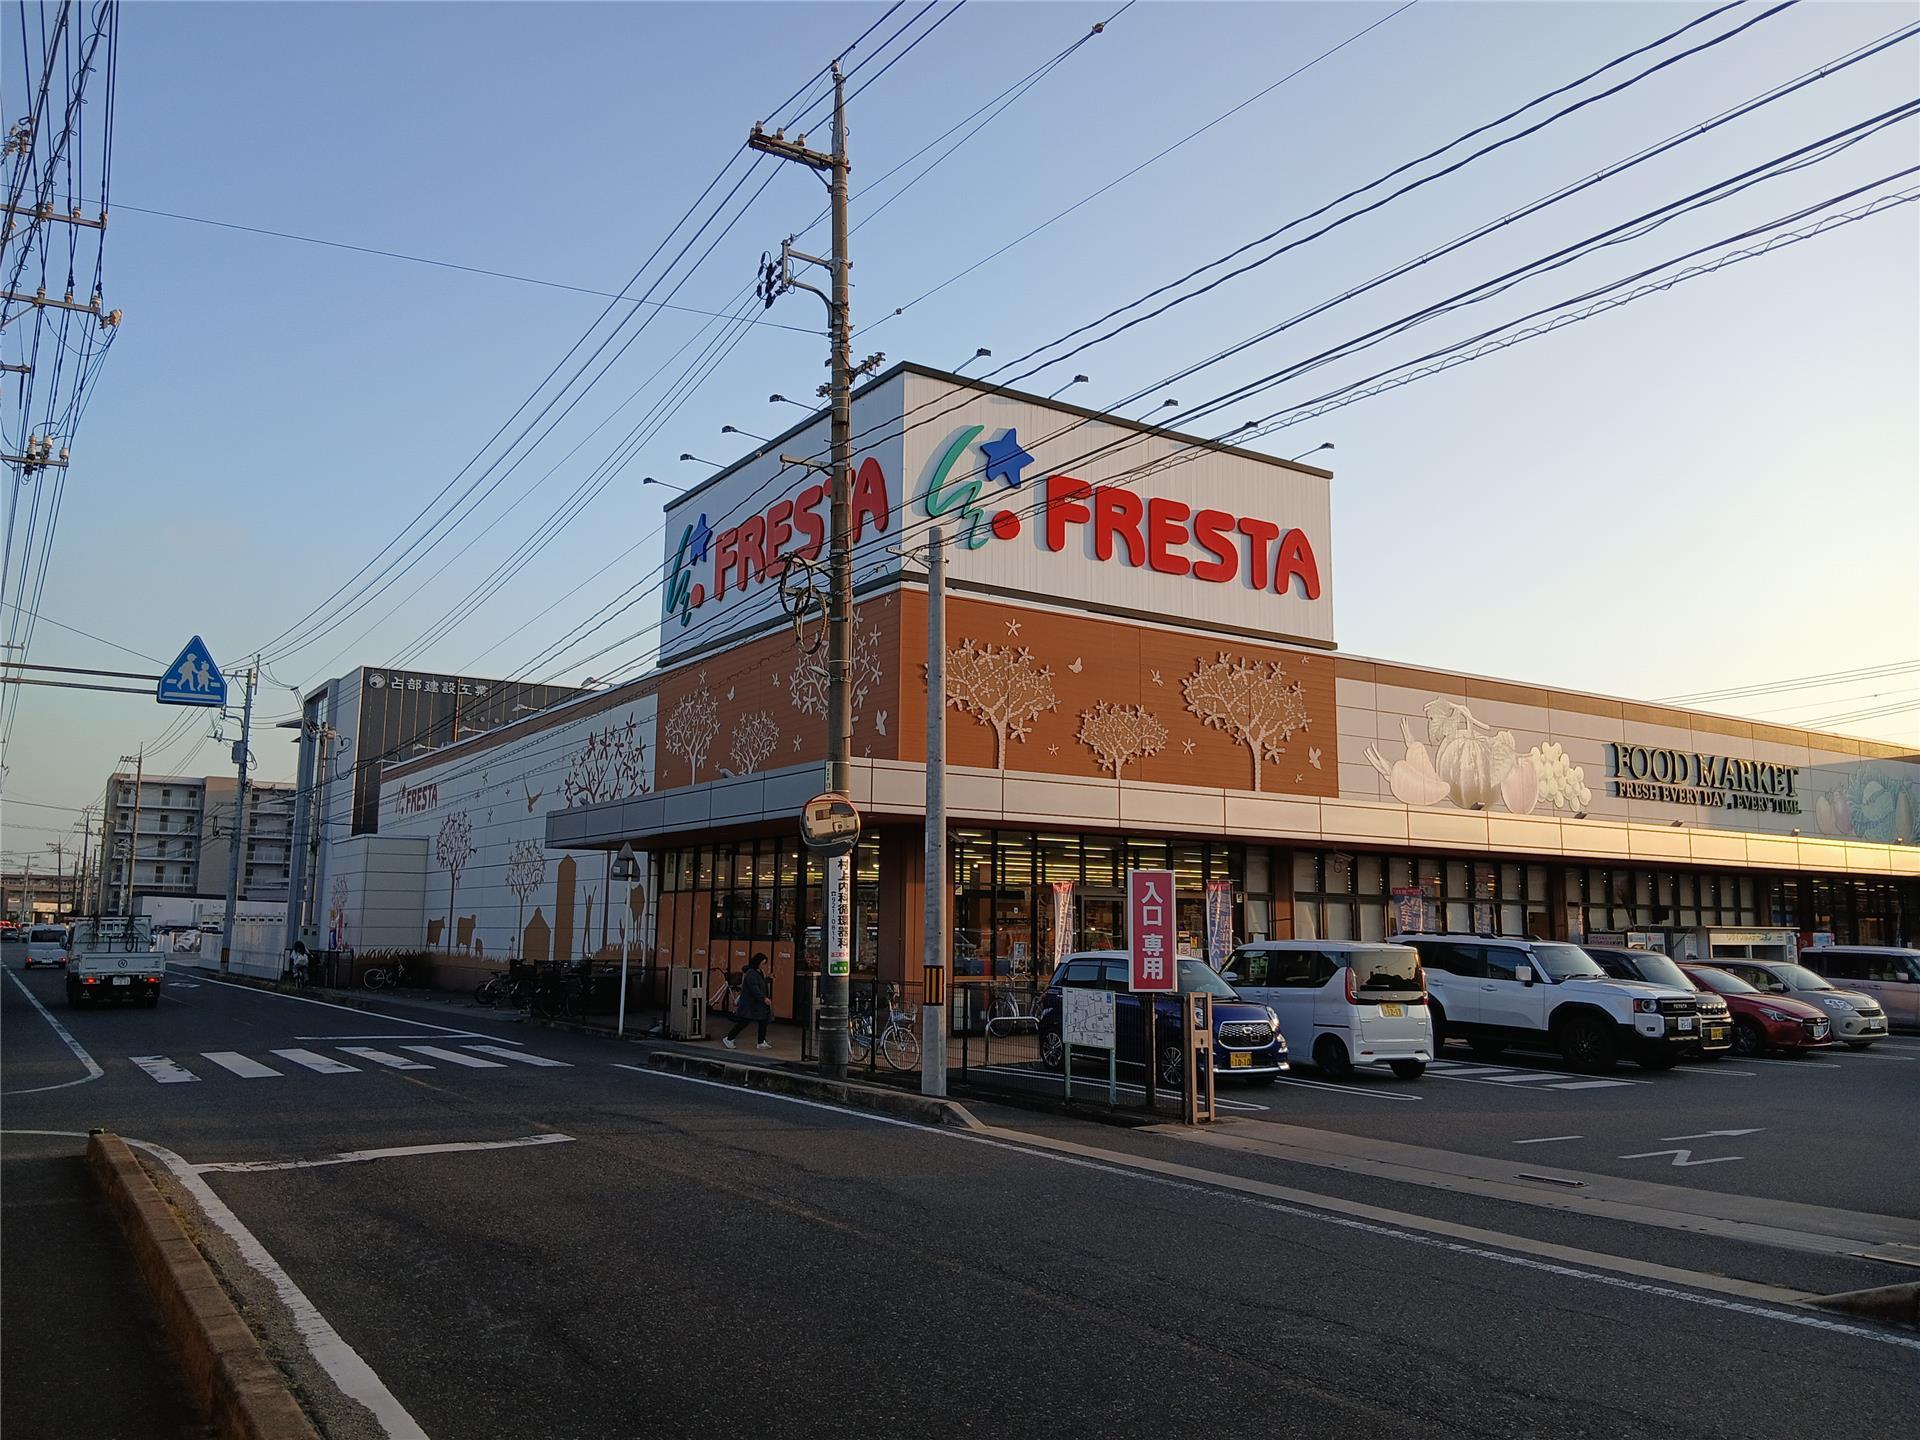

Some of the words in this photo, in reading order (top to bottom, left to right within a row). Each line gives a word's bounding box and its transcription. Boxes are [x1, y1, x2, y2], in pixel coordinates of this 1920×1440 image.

[1046, 475, 1321, 600] FRESTA
[391, 676, 488, 698] 占部建設工業
[1612, 742, 1690, 785] FOOD
[1694, 752, 1800, 797] MARKET
[1616, 781, 1662, 801] FRESH
[1663, 785, 1701, 806] EVERY
[1736, 794, 1770, 812] EVERY
[406, 783, 438, 814] FRESTA
[837, 858, 849, 949] 村上内科循環器科
[1141, 881, 1164, 980] 入口専用
